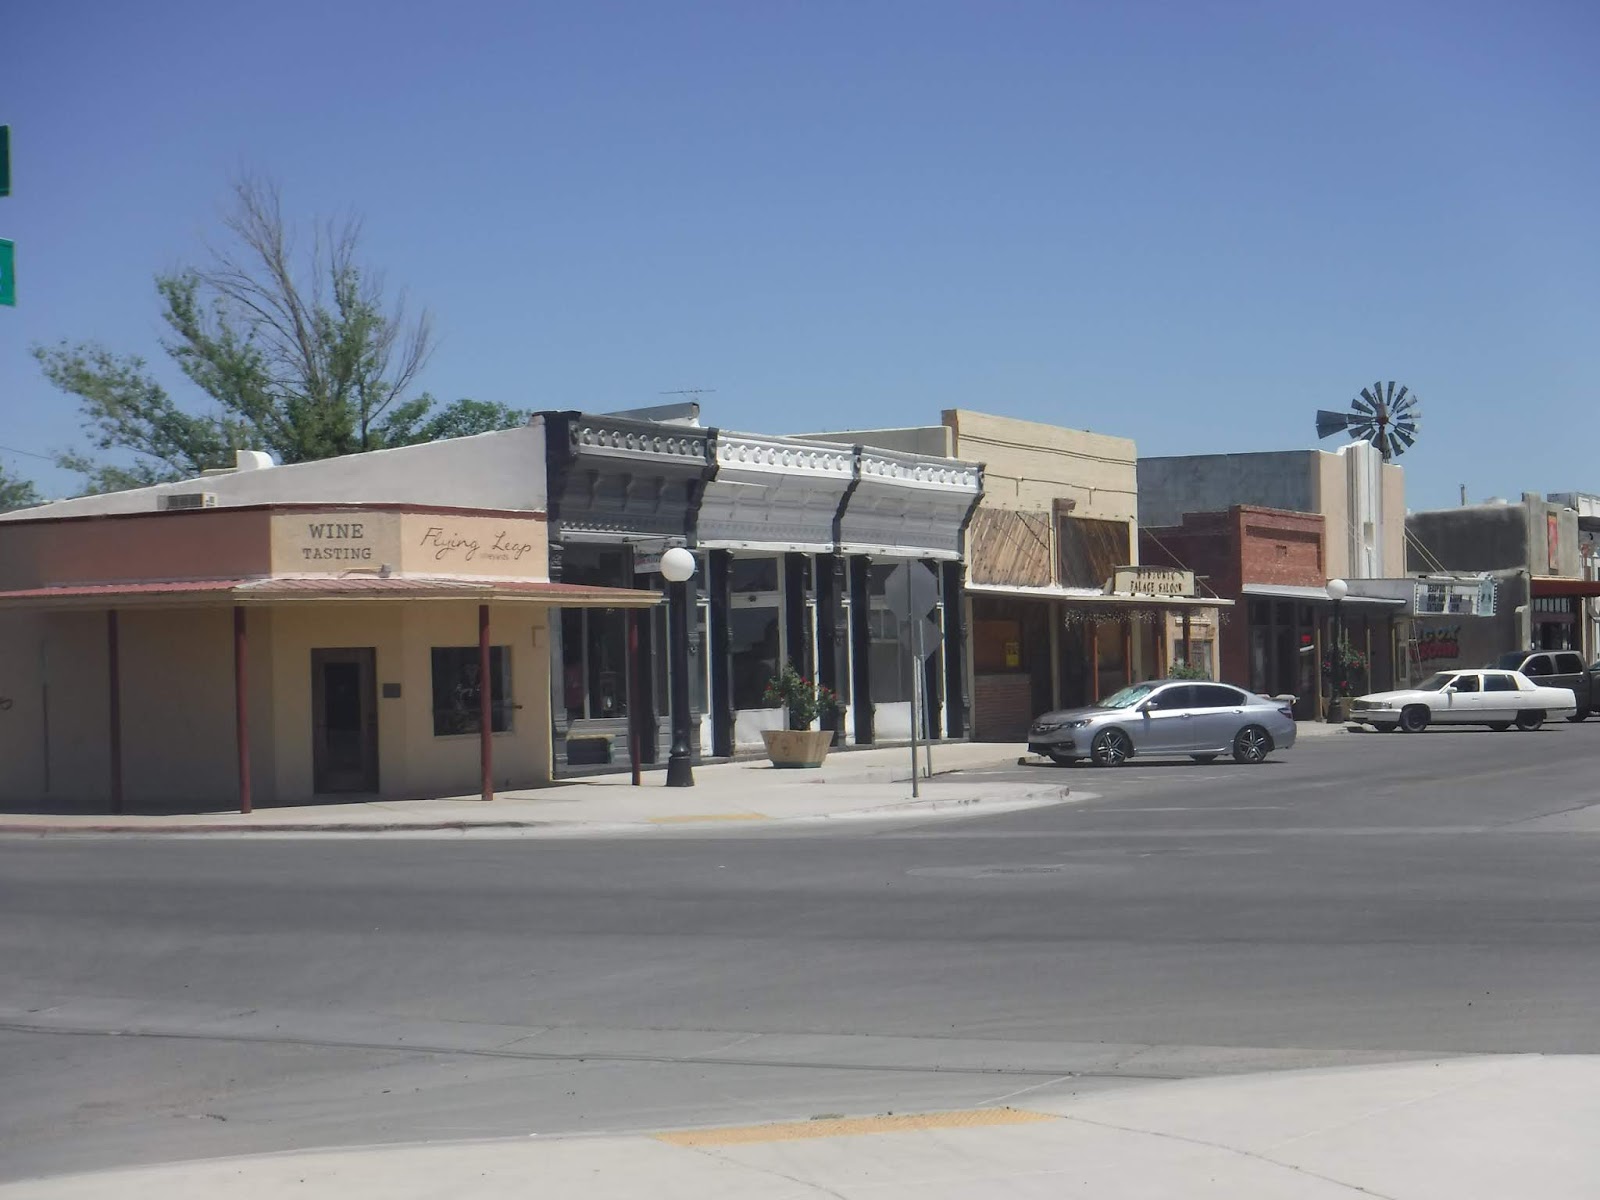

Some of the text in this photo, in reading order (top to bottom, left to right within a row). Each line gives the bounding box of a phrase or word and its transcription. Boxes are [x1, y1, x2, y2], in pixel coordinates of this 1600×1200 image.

[308, 523, 364, 539] WINE
[420, 527, 532, 561] Flying Leap
[302, 547, 372, 560] TASTING
[1130, 580, 1182, 594] PALACE SALOON
